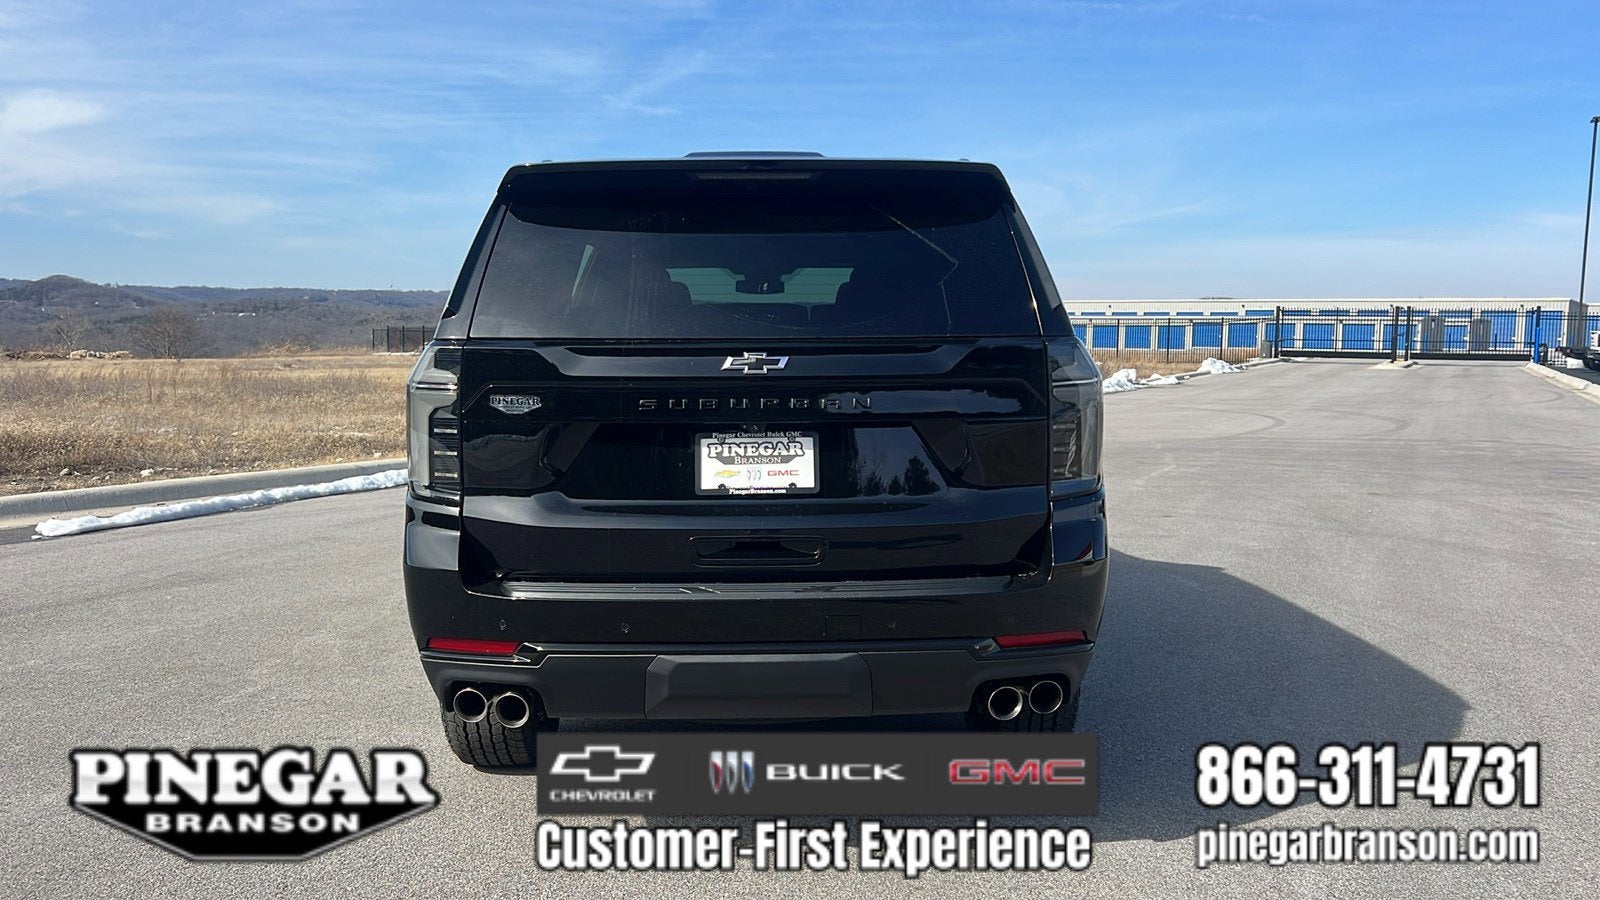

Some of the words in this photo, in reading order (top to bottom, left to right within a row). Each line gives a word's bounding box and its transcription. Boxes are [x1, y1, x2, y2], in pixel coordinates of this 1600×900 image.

[490, 396, 541, 406] PINEGAR
[638, 397, 871, 410] SUBURBAN
[708, 442, 805, 457] PINEGAR
[734, 456, 781, 465] BRANSON
[767, 469, 799, 477] GMC
